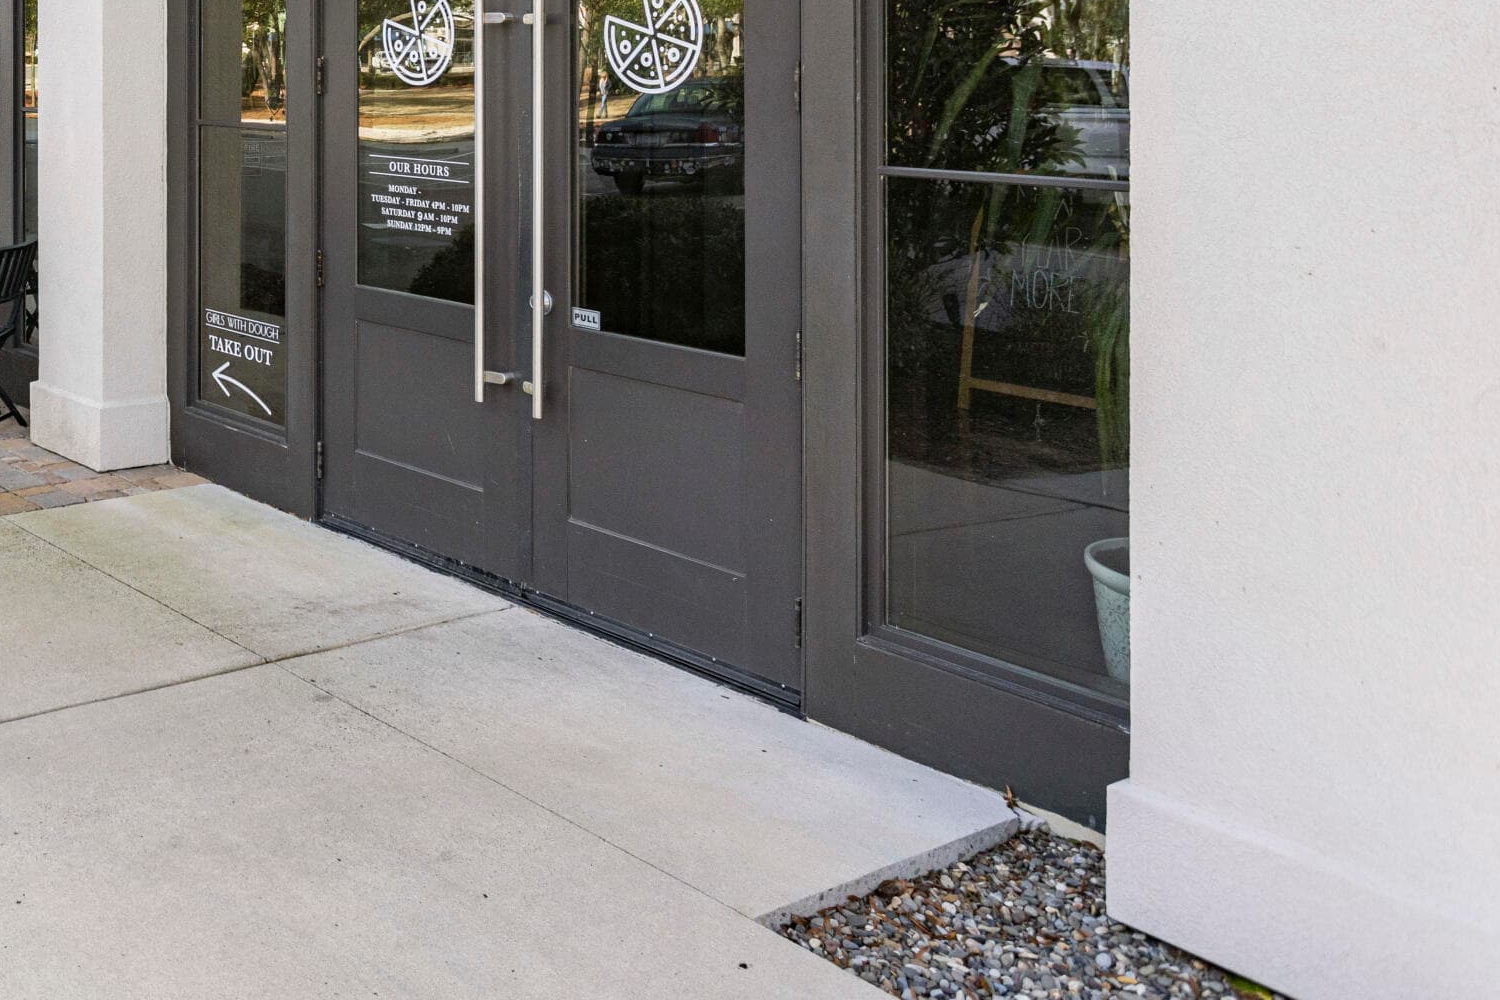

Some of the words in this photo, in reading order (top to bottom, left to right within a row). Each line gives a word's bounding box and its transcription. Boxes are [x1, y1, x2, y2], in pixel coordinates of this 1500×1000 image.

[388, 161, 411, 174] OUR
[413, 163, 450, 177] HOURS
[388, 184, 417, 195] MONDAY
[371, 193, 401, 205] TUESDAY
[405, 198, 430, 209] FRIDAY
[431, 201, 446, 211] 4PM
[451, 203, 470, 214] 10PM
[381, 207, 416, 219] SATURDAY
[440, 214, 458, 224] 10PM
[386, 219, 413, 231] SUNDAY
[414, 223, 432, 233] 12PM
[205, 311, 226, 327] GIRLS
[227, 315, 247, 332] WITH
[248, 321, 279, 341] DOUGH
[574, 312, 598, 324] PULL
[208, 334, 242, 358] TAKE
[244, 344, 273, 366] OUT
